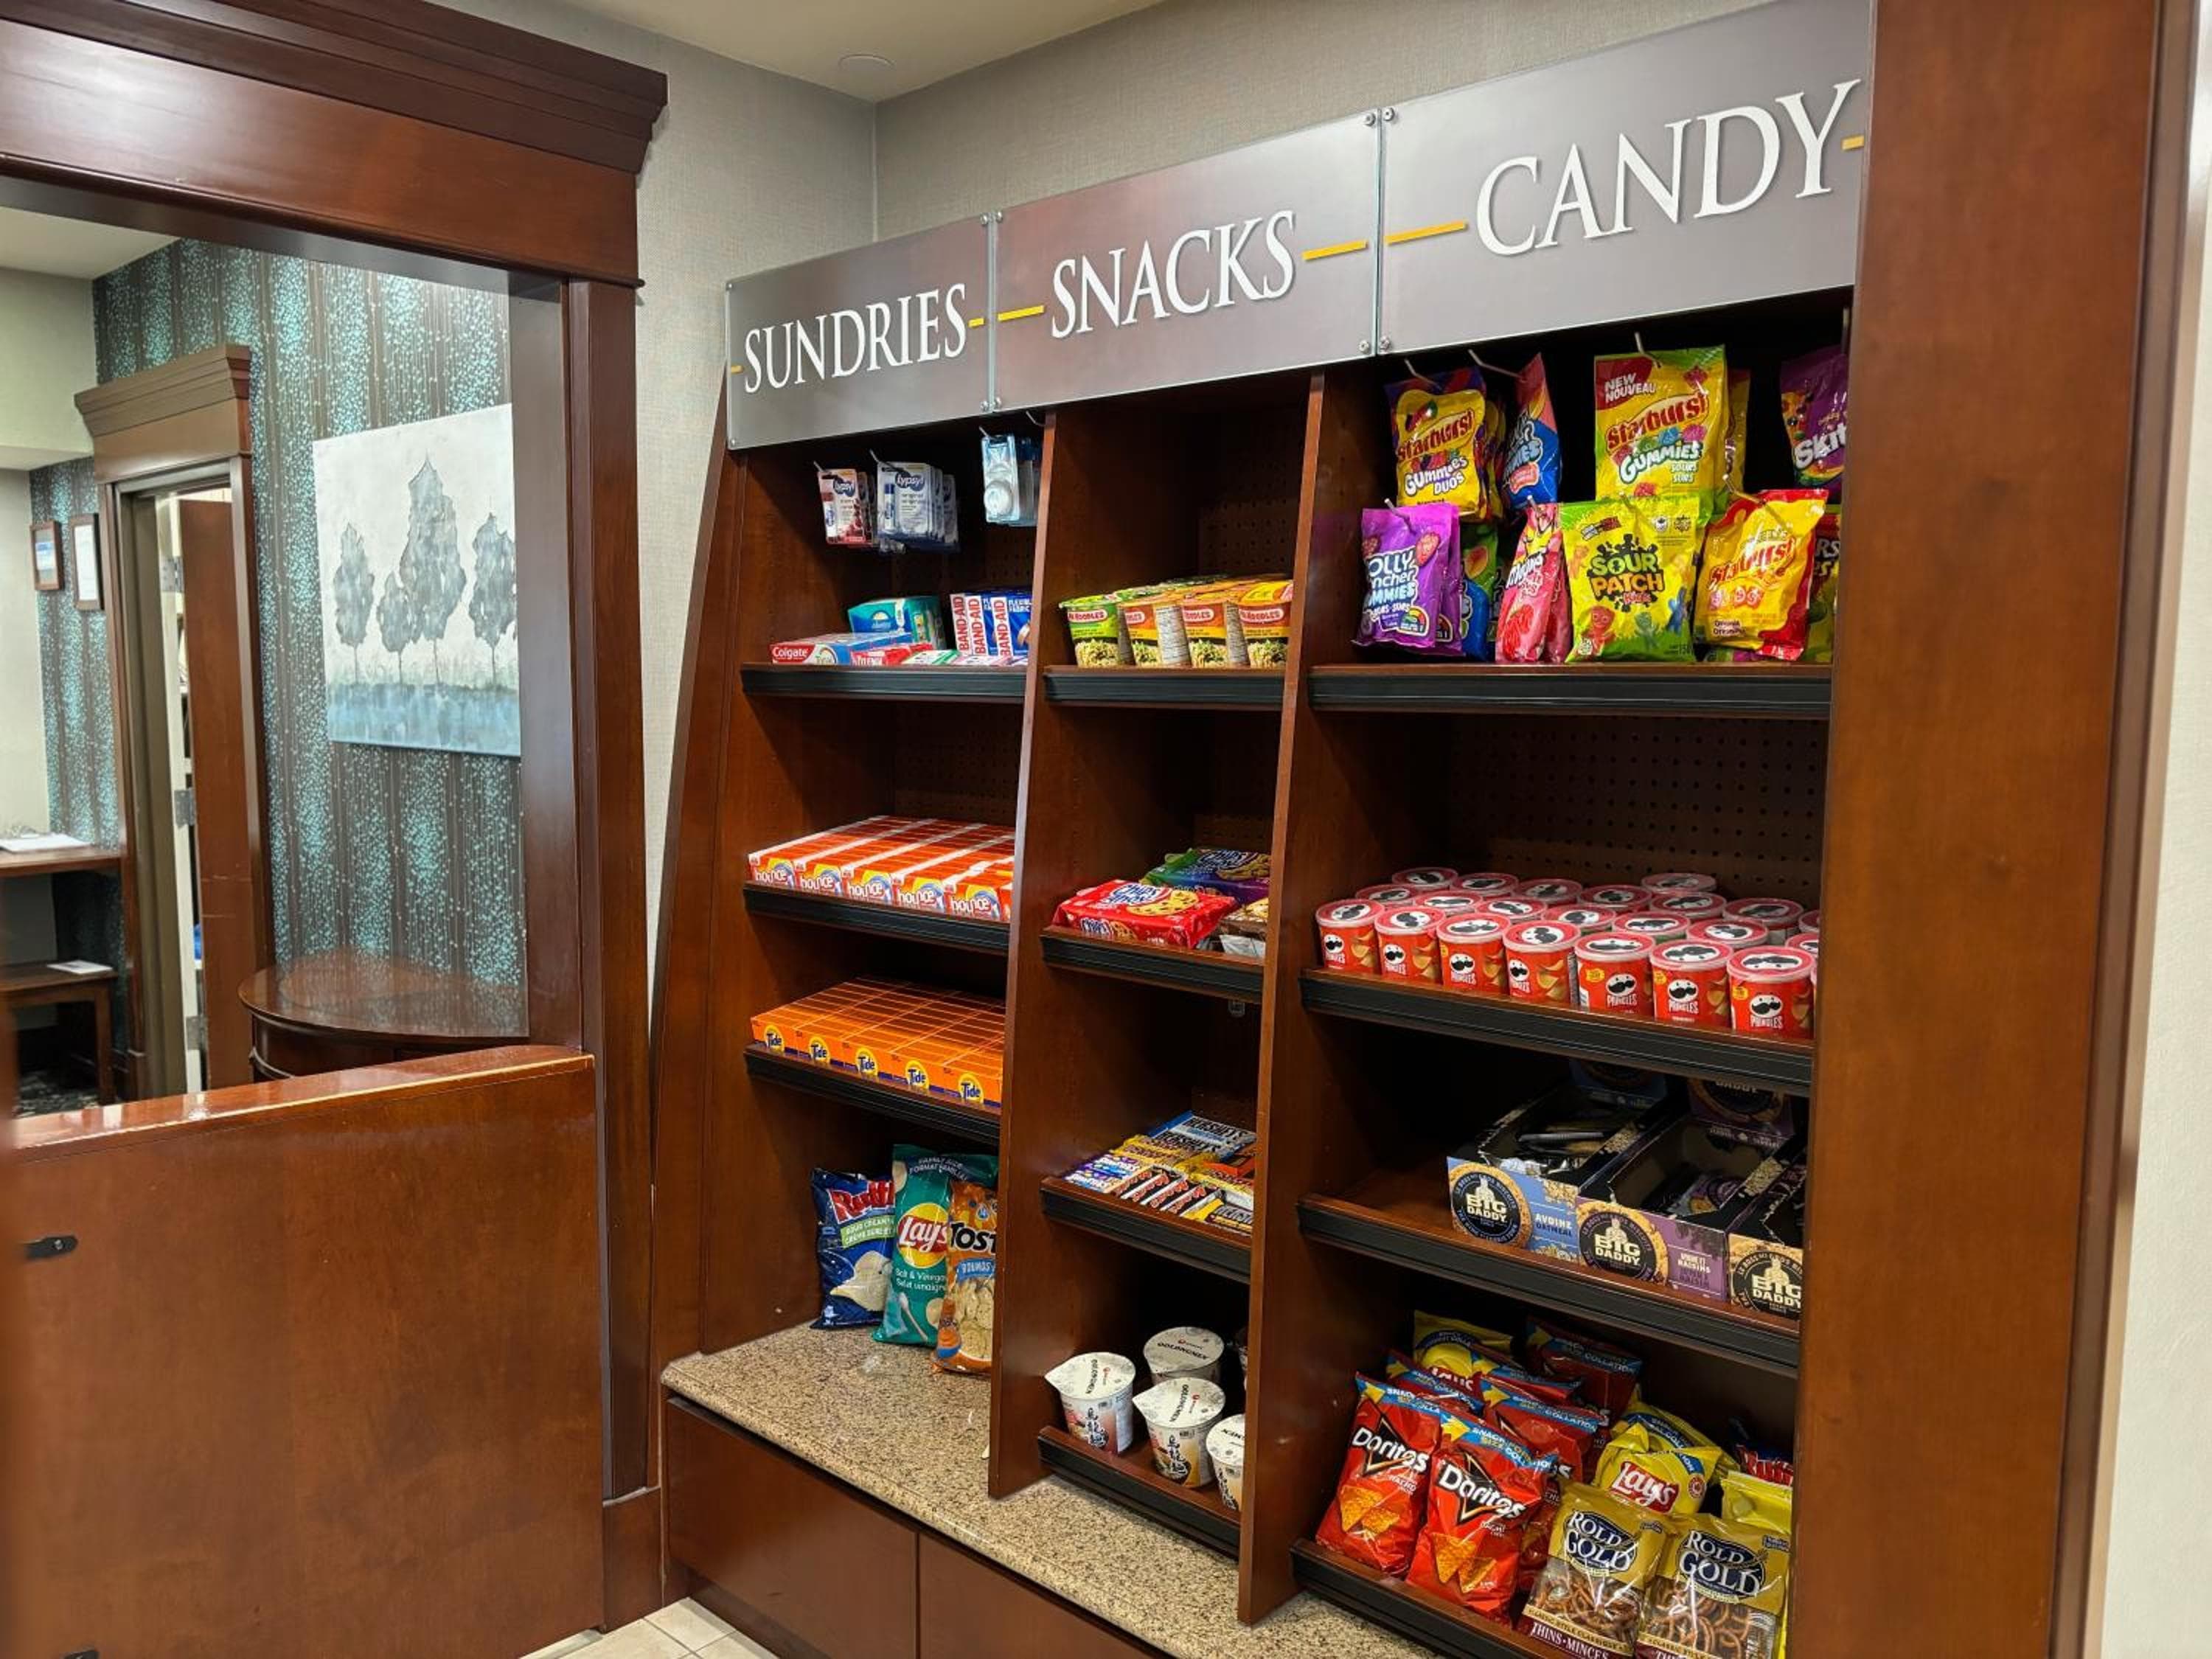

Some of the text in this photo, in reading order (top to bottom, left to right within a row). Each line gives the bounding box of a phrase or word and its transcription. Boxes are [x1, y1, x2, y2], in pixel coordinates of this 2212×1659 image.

[1476, 79, 1862, 256] CANDY
[1051, 210, 1295, 339] SNACKS
[744, 282, 967, 394] SUNDRIES
[1604, 373, 1636, 390] NEW
[1605, 383, 1657, 404] NOUVEAU
[1592, 552, 1658, 576] SOUR
[1591, 572, 1664, 597] PATCH
[773, 645, 809, 661] Colgate
[766, 1032, 782, 1048] Tide
[810, 1043, 827, 1061] Tide
[858, 1056, 875, 1074] Tide
[908, 1068, 927, 1085] Tide
[961, 1082, 981, 1100] Tide
[1467, 1193, 1506, 1214] BIG
[1467, 1206, 1508, 1222] DADDY
[1594, 1234, 1641, 1257] BIG
[1595, 1246, 1641, 1266] DADDY
[1752, 1273, 1802, 1301] BIG
[1352, 1427, 1430, 1473] Doritos
[1439, 1464, 1526, 1519] Doritos
[1611, 1462, 1677, 1507] Lay's
[1568, 1512, 1621, 1547] ROLD
[1565, 1529, 1632, 1572] GOLD
[1687, 1529, 1745, 1564] ROLD
[1679, 1551, 1764, 1597] GOLD
